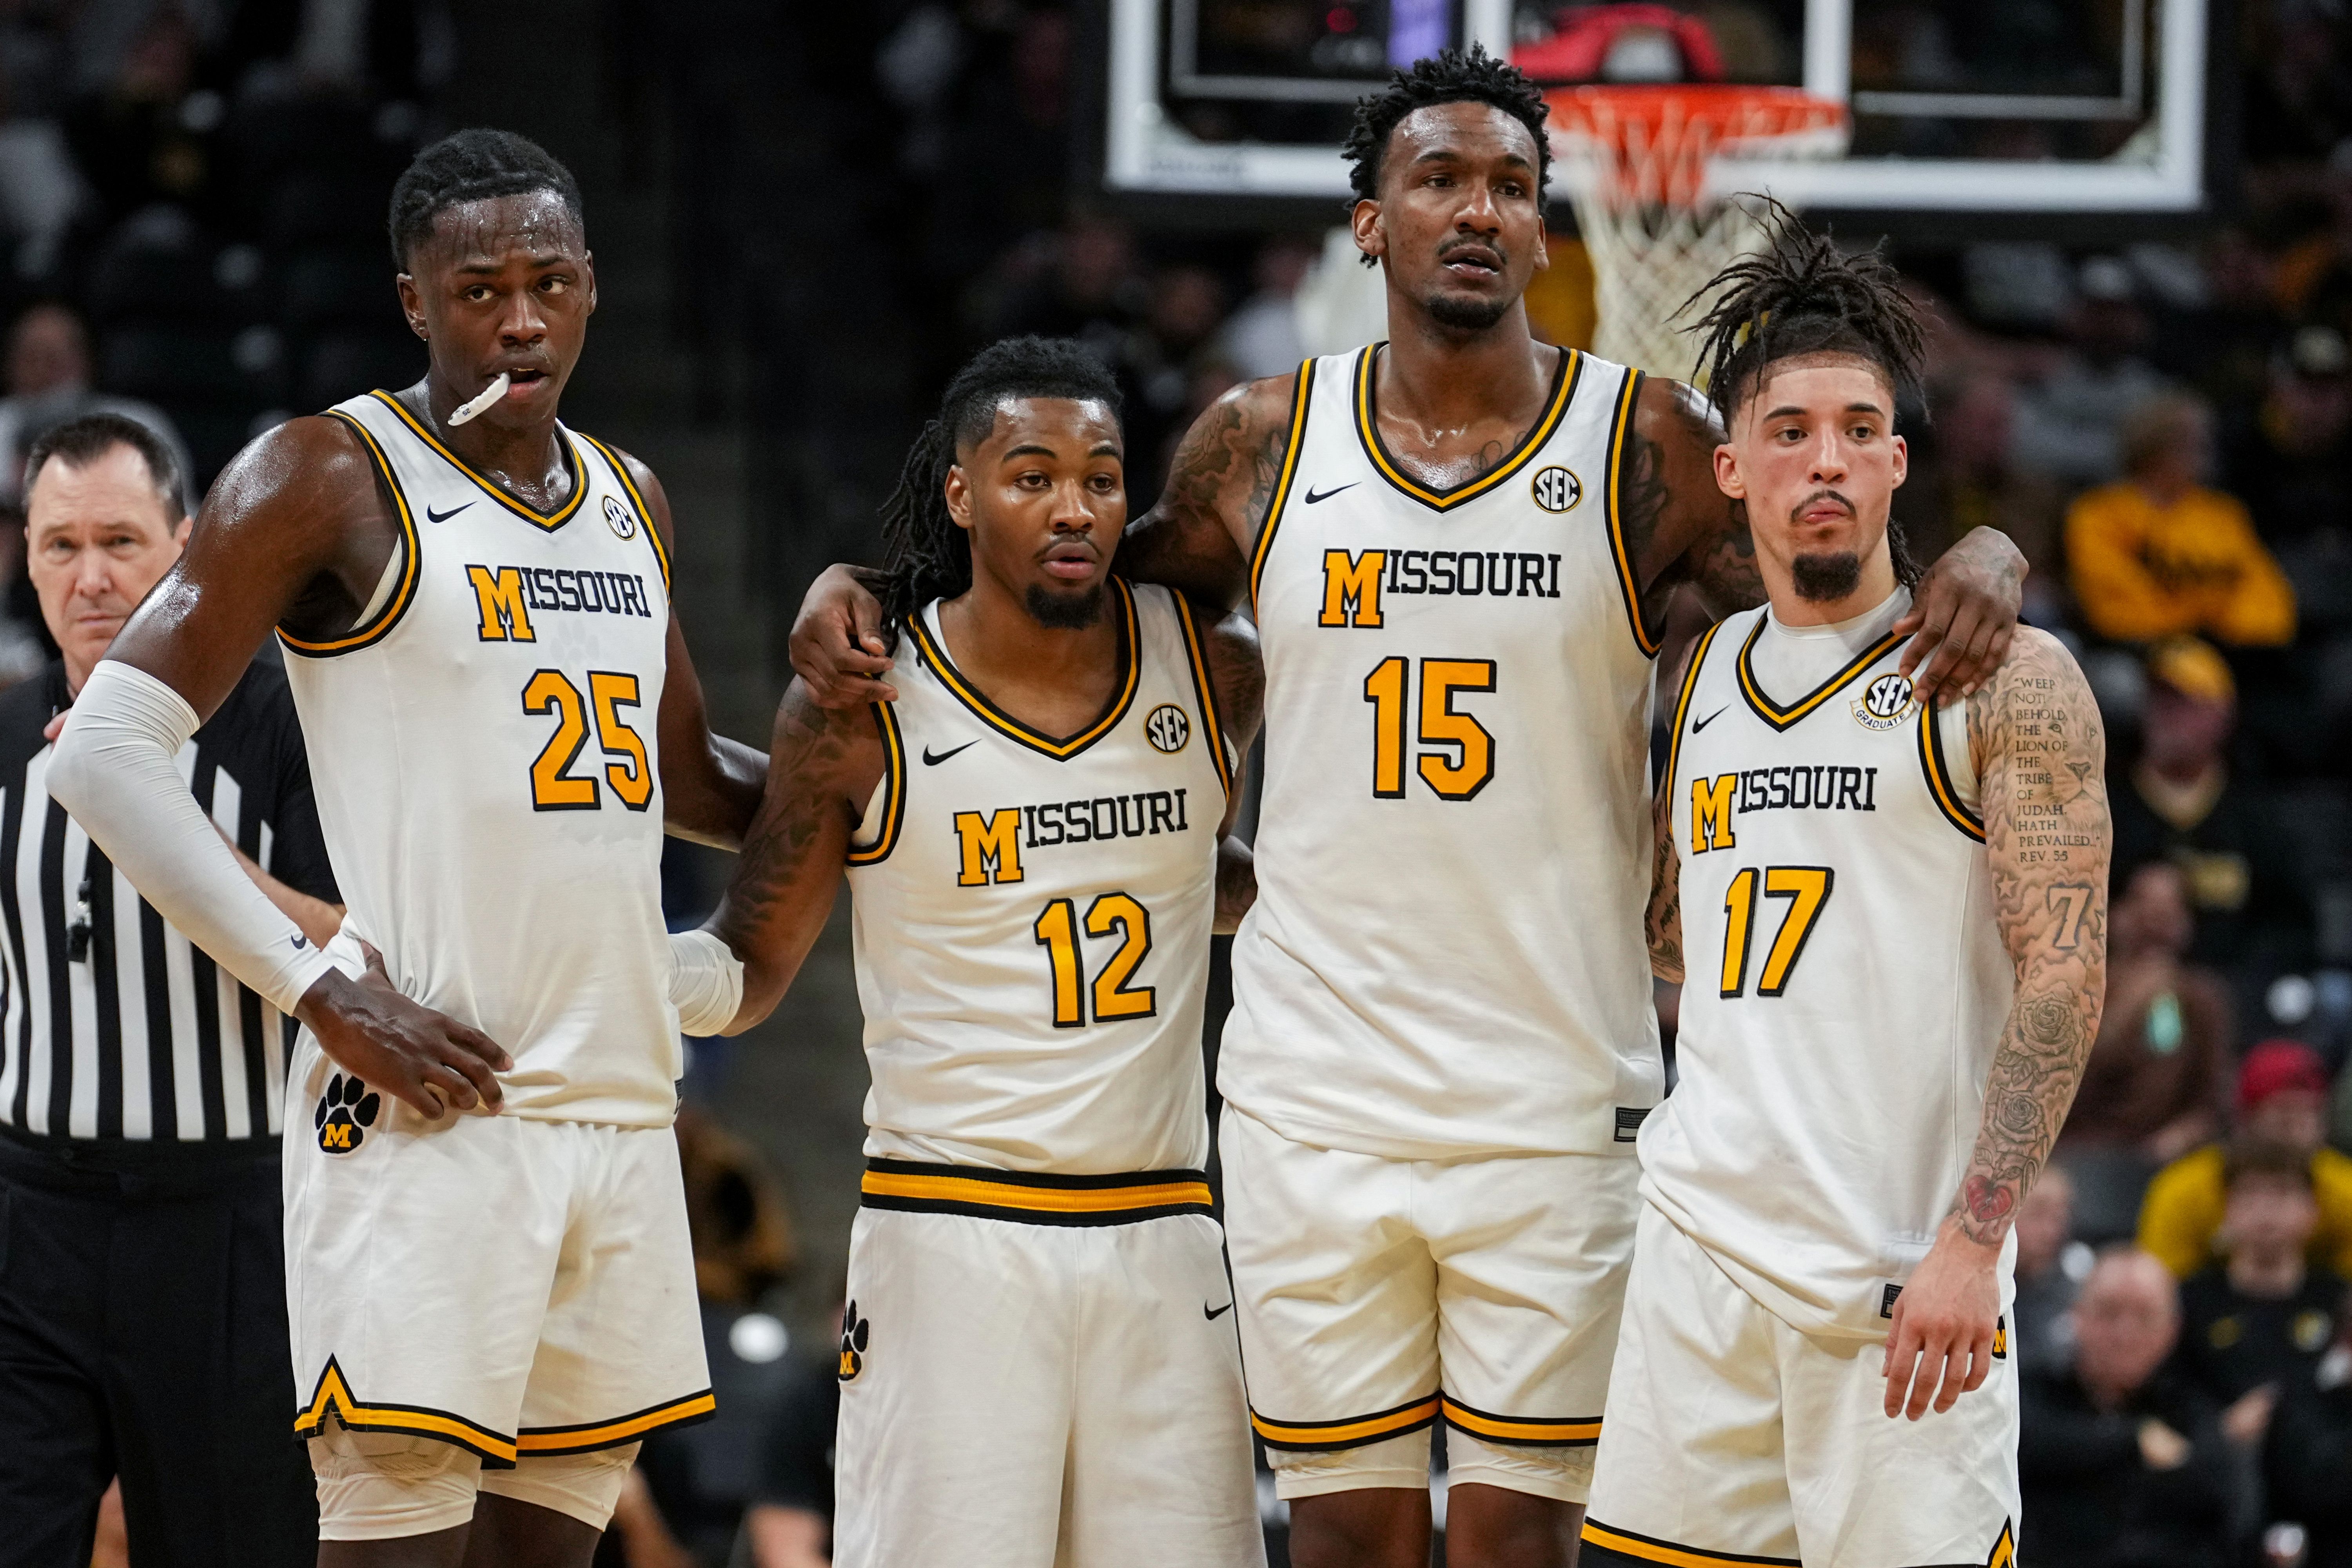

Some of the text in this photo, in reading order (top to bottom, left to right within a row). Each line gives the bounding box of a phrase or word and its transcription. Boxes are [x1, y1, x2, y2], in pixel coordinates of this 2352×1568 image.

[1535, 468, 1579, 510] SEC
[604, 497, 633, 537] SEC
[464, 564, 652, 643] MISSOURI
[1318, 548, 1562, 629] MISSOURI
[1867, 676, 1911, 715] SEC
[1148, 707, 1187, 751] SEC
[1363, 656, 1497, 801] 15
[1856, 710, 1906, 728] GRADUATE
[2015, 725, 2041, 736] THE
[521, 668, 654, 812] 25
[2016, 740, 2068, 752] LION OF
[2016, 756, 2041, 768] THE
[2016, 773, 2053, 784] TRIBE
[1691, 765, 1878, 856] MISSOURI
[2016, 789, 2034, 800] OF
[953, 788, 1188, 887] MISSOURI
[2018, 820, 2058, 831] HATH
[2020, 850, 2051, 862] REV.
[1720, 866, 1834, 1000] 17
[2047, 882, 2094, 951] 7
[1034, 891, 1157, 1028] 12
[323, 1123, 352, 1147] M
[839, 1351, 855, 1374] M
